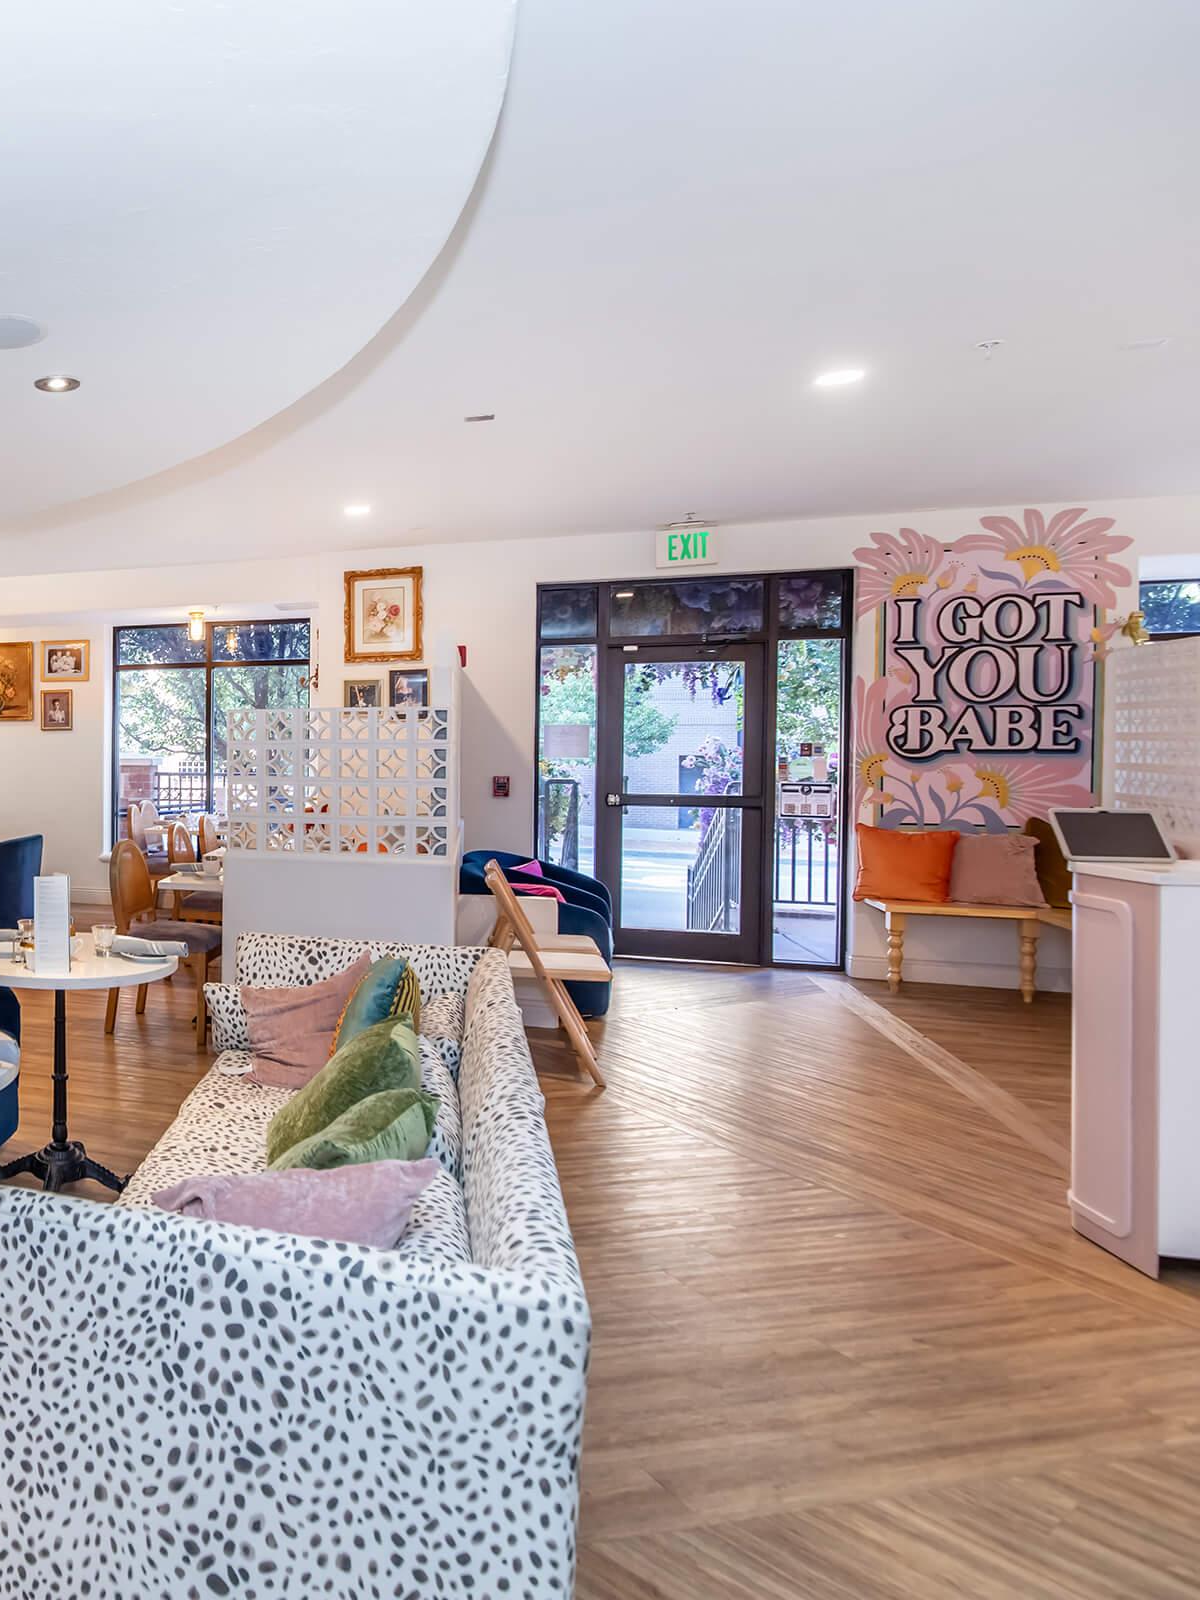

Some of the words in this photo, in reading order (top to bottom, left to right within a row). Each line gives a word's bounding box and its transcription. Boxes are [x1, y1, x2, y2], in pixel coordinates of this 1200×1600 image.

[668, 531, 709, 561] EXIT
[892, 599, 921, 643] I
[936, 591, 1083, 643] GOT
[894, 644, 1077, 704] YOU
[886, 704, 1082, 758] BABE
